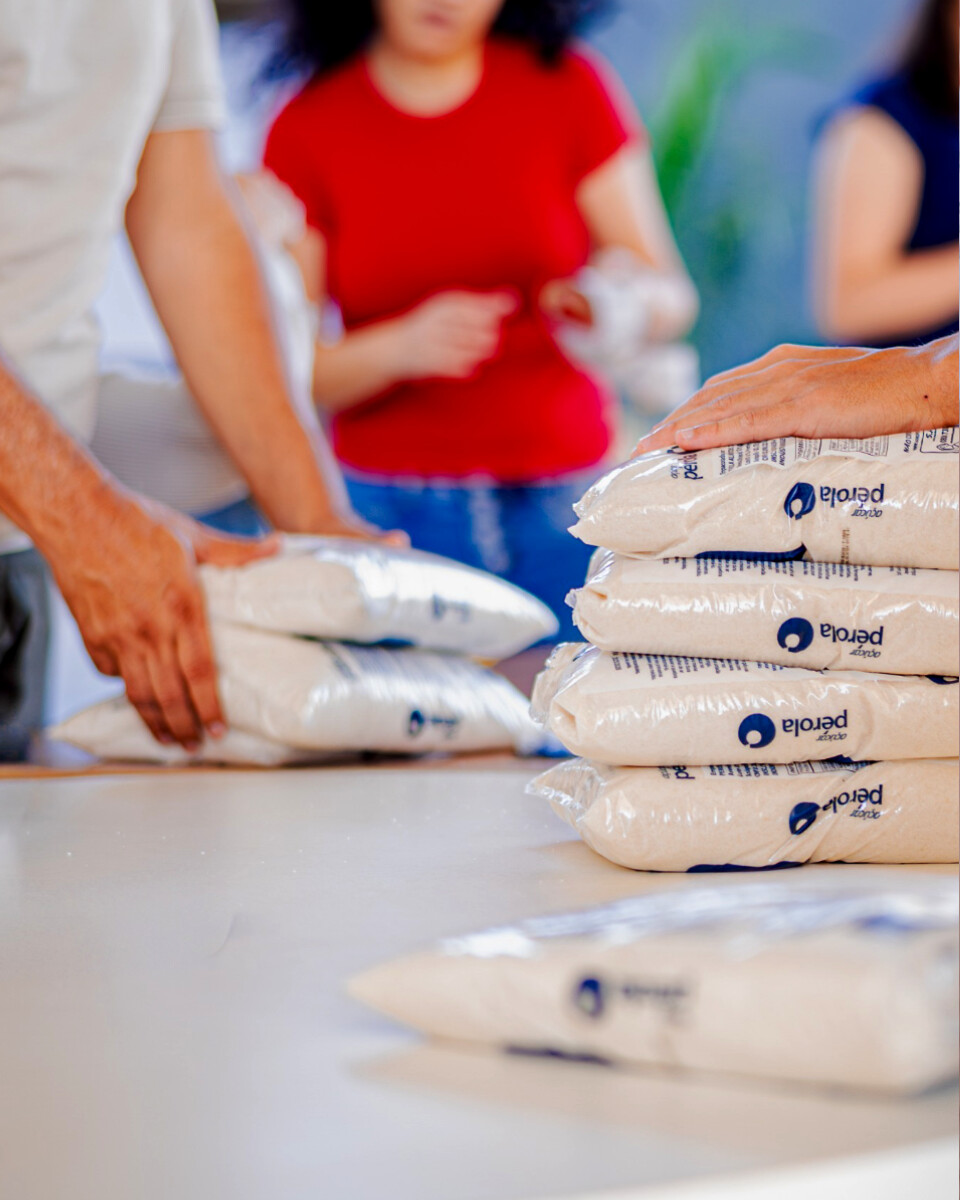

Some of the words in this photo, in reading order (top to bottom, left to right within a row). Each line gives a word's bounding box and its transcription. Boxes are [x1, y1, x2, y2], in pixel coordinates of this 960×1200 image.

[820, 482, 885, 510] pérola
[819, 623, 884, 649] pérola
[782, 709, 848, 737] pérola
